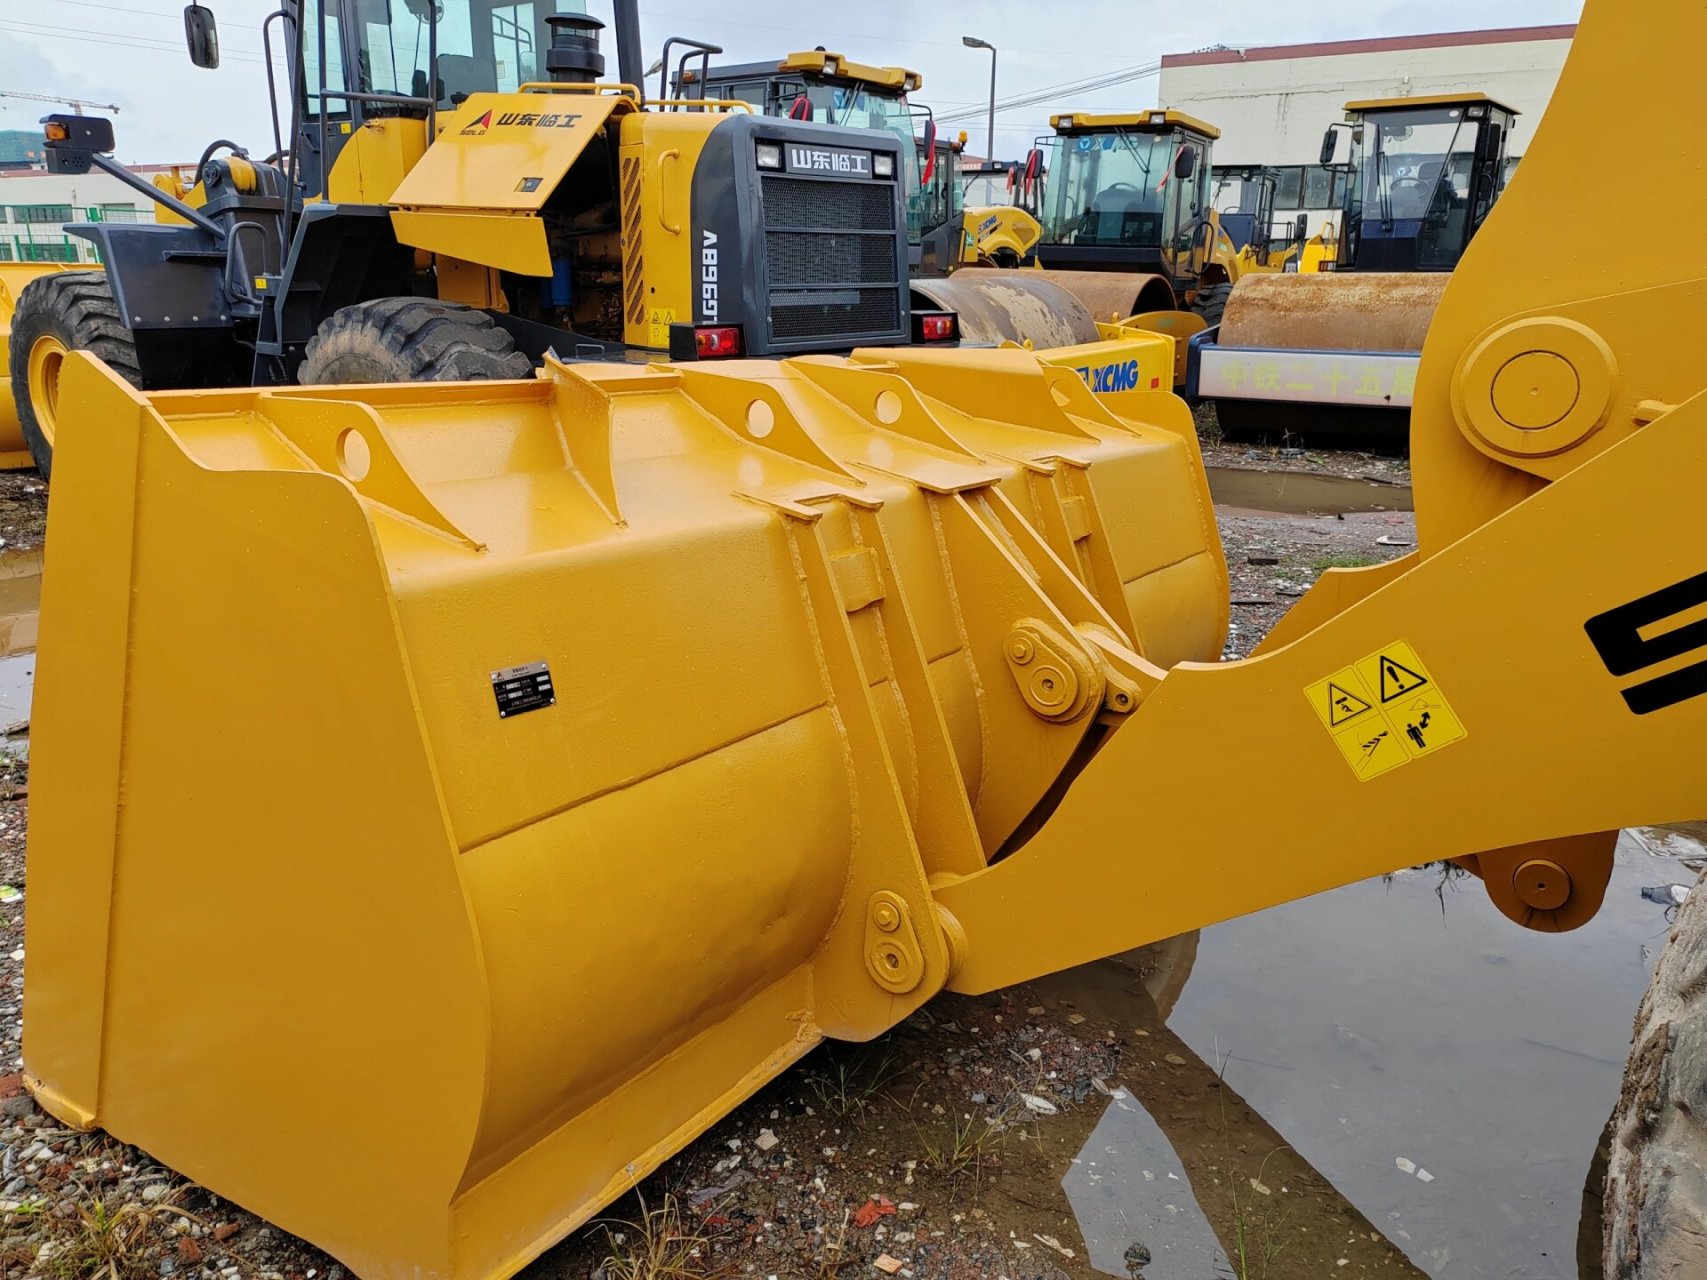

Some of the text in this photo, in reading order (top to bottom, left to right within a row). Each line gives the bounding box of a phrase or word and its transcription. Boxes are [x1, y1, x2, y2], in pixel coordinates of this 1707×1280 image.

[496, 113, 582, 128] 山东临工
[791, 149, 869, 174] 山东临工
[1091, 359, 1139, 393] XCMG
